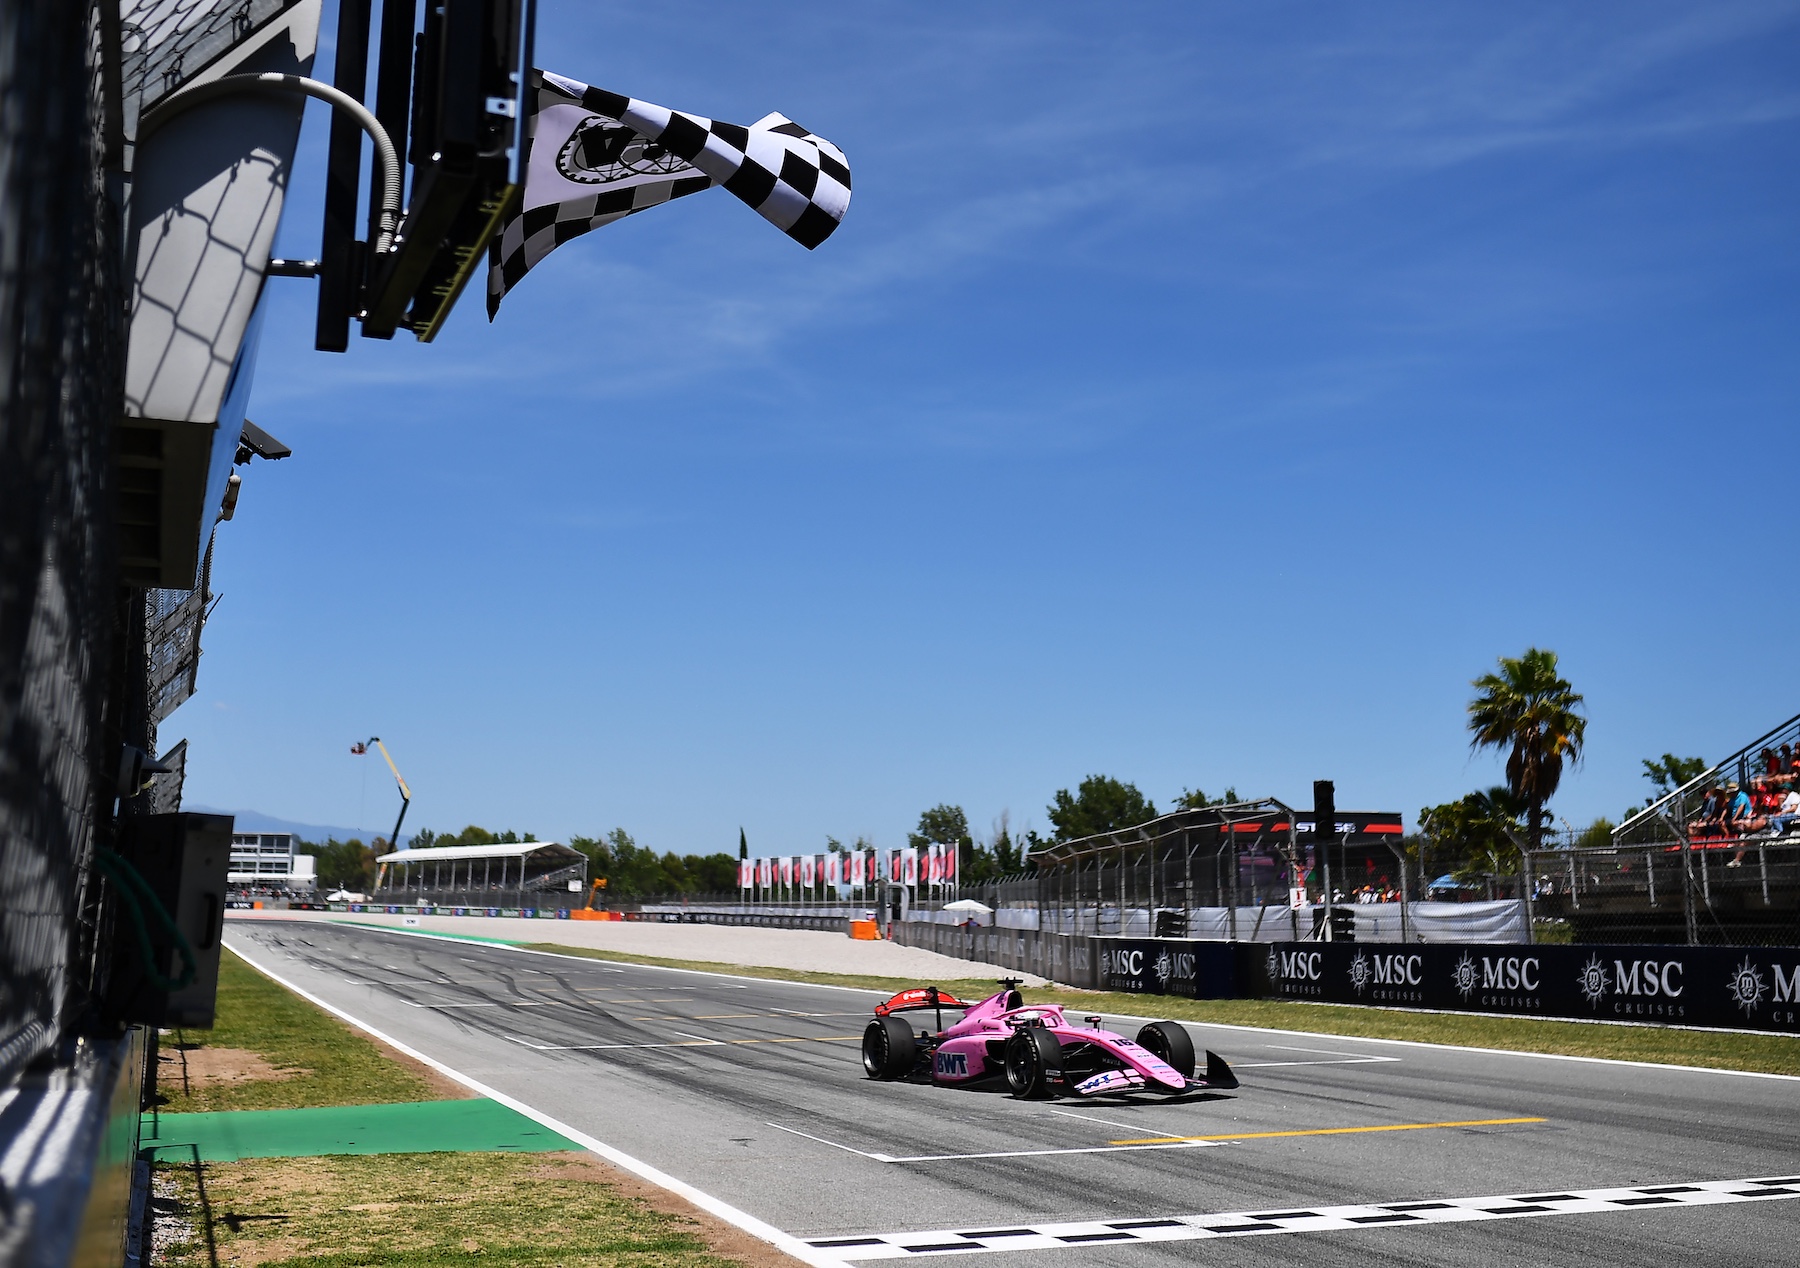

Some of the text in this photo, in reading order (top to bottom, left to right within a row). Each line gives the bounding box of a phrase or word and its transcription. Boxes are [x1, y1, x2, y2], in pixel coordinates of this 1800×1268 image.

[1111, 950, 1143, 976] MSC
[1281, 951, 1322, 981] MSC
[1373, 954, 1422, 986] MSC
[1482, 957, 1540, 991] MSC
[1614, 960, 1684, 998] MSC
[1373, 989, 1423, 1001] CRUISES
[1482, 995, 1541, 1009] CRUISES
[1614, 1002, 1685, 1016] CRUISES
[1109, 1039, 1135, 1047] 16
[937, 1051, 970, 1077] BWT
